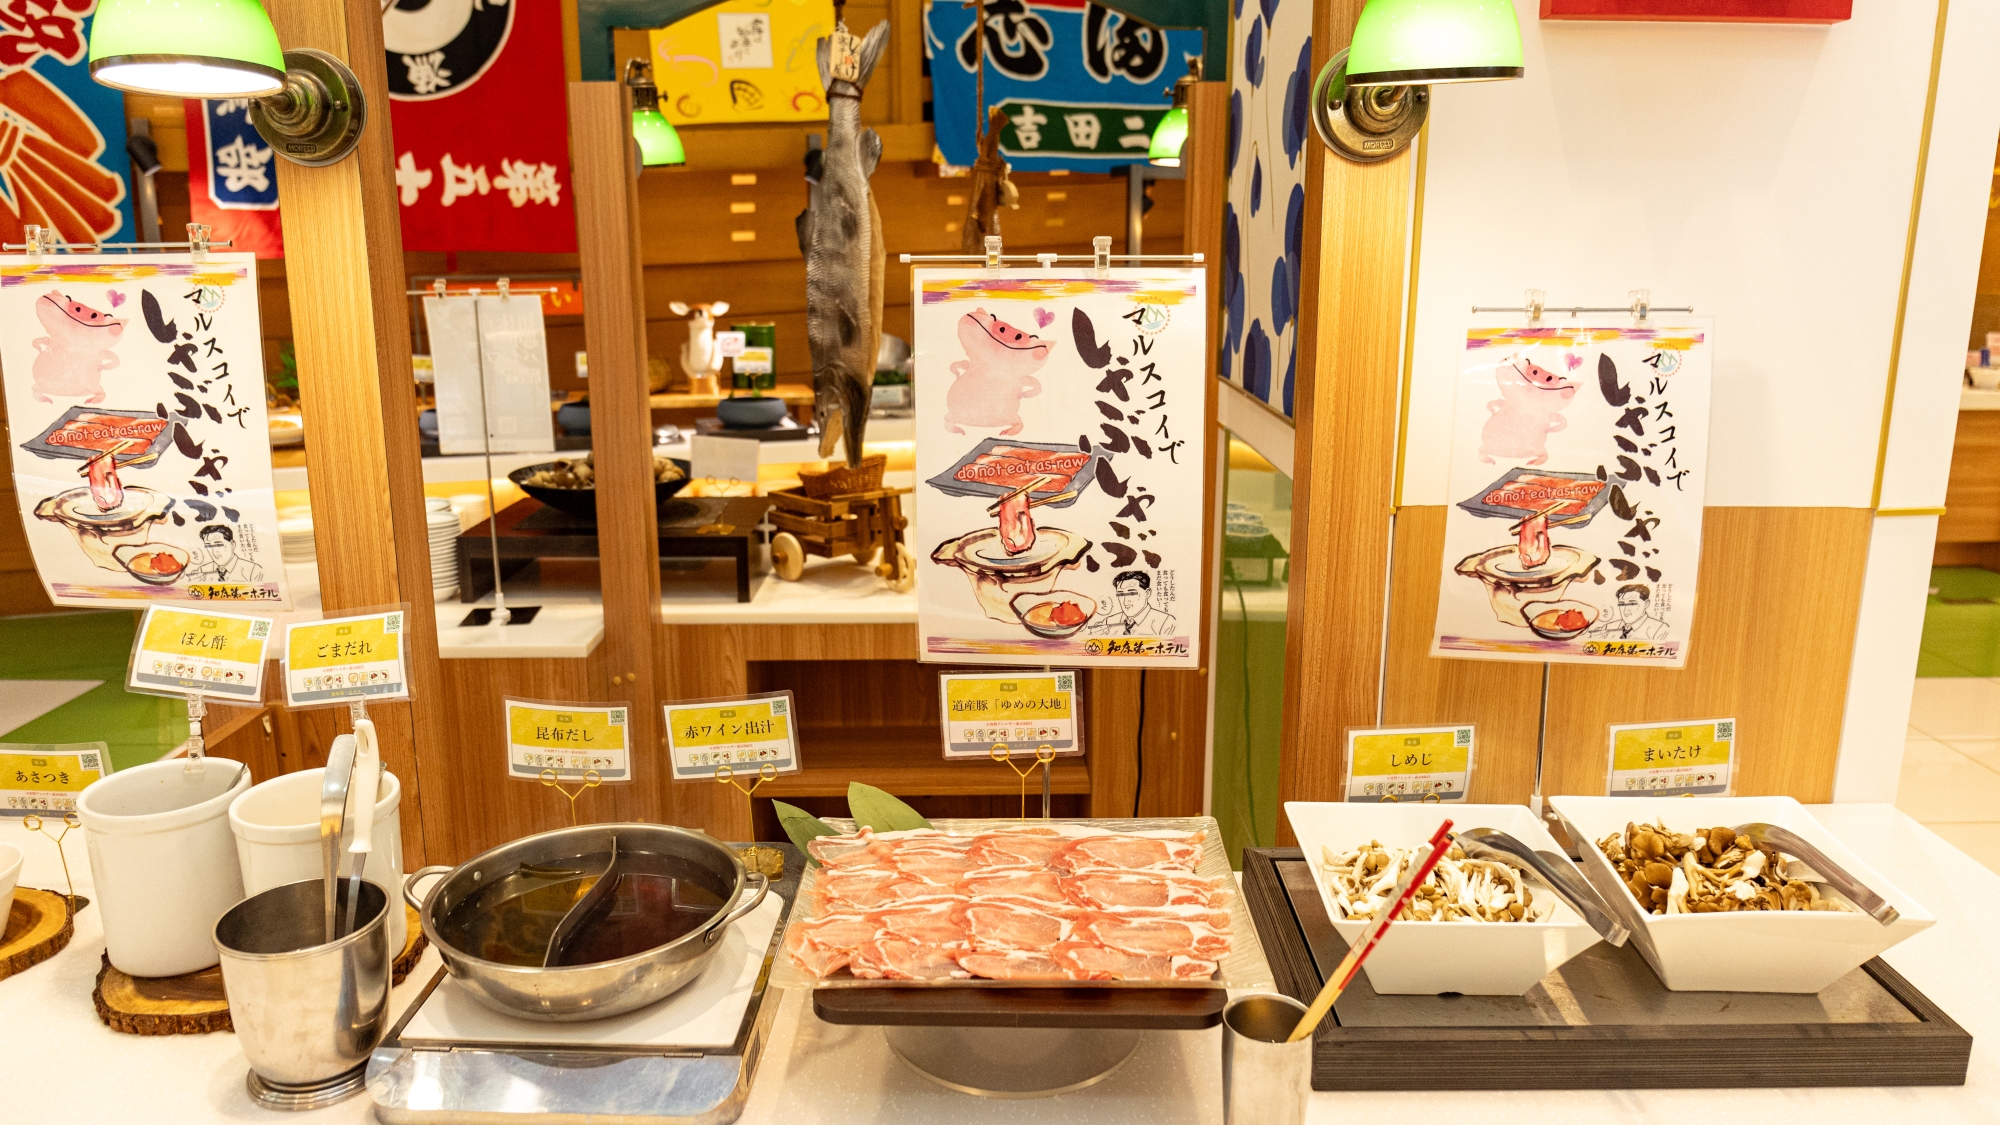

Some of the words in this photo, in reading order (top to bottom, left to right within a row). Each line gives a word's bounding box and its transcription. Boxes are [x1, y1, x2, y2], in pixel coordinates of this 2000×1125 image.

[184, 288, 250, 429] マルスコイで
[1123, 308, 1185, 465] マルスコイで
[141, 289, 240, 526] しゃぶしゃぶ
[1642, 352, 1690, 491] マルスコイで
[49, 433, 64, 443] do
[68, 430, 88, 440] not
[94, 426, 115, 438] eat
[120, 426, 133, 436] as
[137, 423, 162, 433] raw
[1072, 307, 1162, 572] しゃぶしゃぶ
[958, 467, 975, 479] do
[978, 465, 1001, 478] not
[1006, 462, 1031, 474] eat
[1036, 461, 1051, 471] as
[1056, 458, 1084, 469] raw
[1593, 352, 1662, 585] しゃぶしゃぶ
[1486, 492, 1500, 503] do
[1505, 489, 1525, 500] not
[1530, 486, 1552, 498] eat
[1556, 487, 1571, 496] as
[1574, 484, 1600, 495] raw
[208, 586, 278, 599] 知床第一ホテル
[181, 632, 228, 650] ぽん酢
[317, 640, 373, 658] ごまだれ
[1107, 640, 1187, 655] 知床第一ホテル
[1602, 643, 1675, 656] 知床第一ホテル
[952, 697, 1068, 712] 道産豚「ゆめの大地」
[536, 726, 594, 742] 昆布だし
[685, 719, 775, 739] 赤ワイン出汁
[1391, 752, 1433, 767] しめじ
[1644, 744, 1702, 761] まいたけ
[16, 770, 69, 784] あさつき
